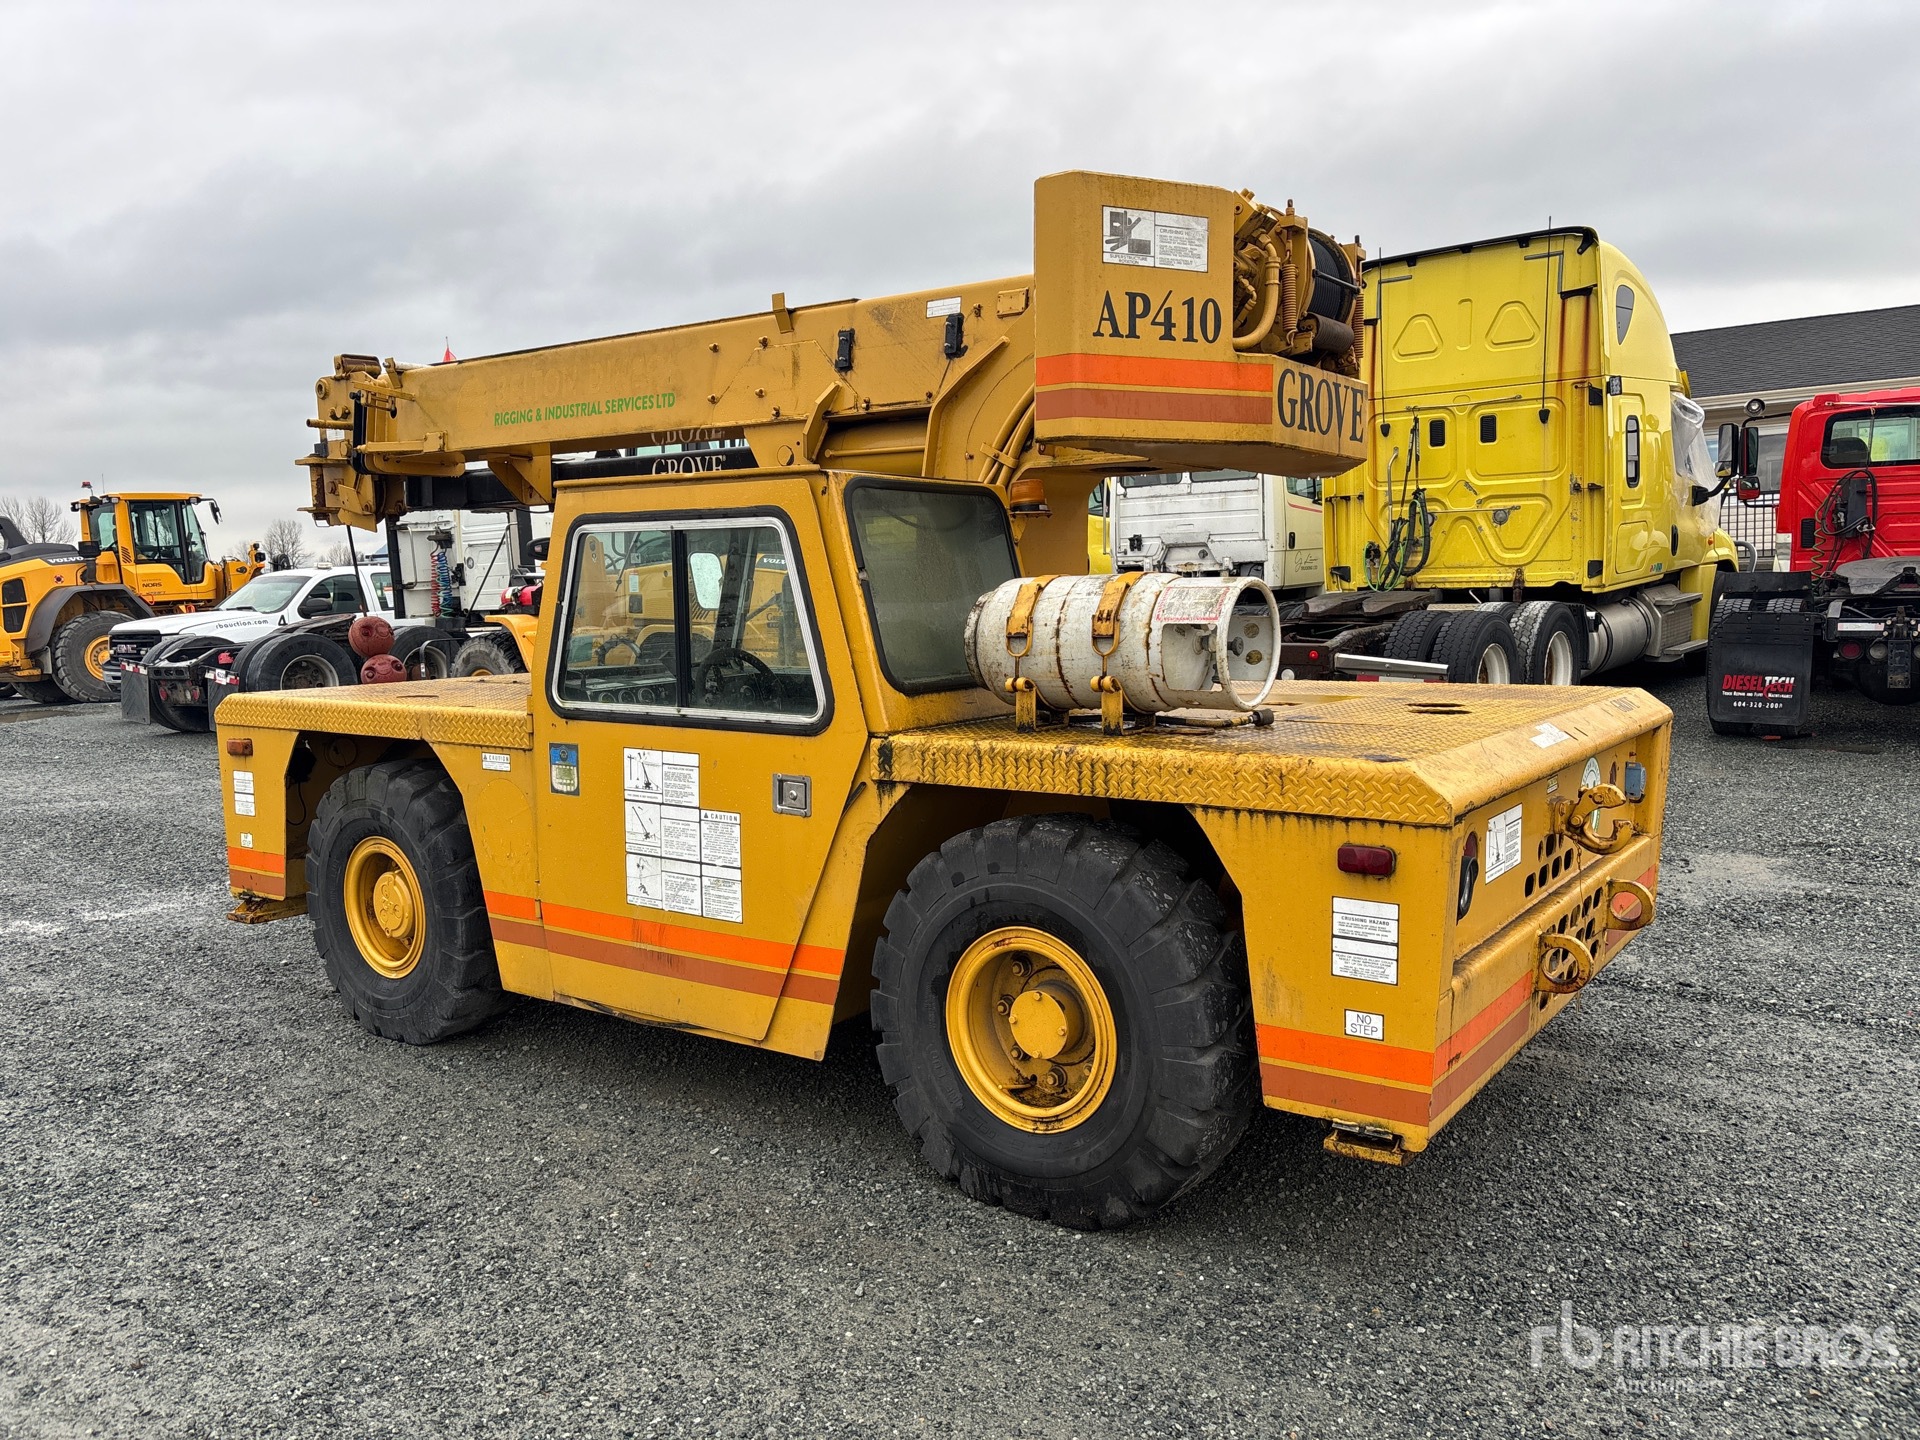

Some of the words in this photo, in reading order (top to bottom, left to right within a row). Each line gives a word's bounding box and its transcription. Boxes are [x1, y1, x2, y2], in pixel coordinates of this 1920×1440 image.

[1092, 289, 1222, 344] AP410
[494, 410, 533, 427] RIGGING
[535, 407, 542, 422] &
[544, 401, 603, 421] INDUSTRIAL
[605, 394, 655, 414] SERVICES
[656, 392, 676, 409] LTD
[1277, 368, 1364, 444] GROVE
[48, 556, 84, 564] VOLVO
[763, 557, 786, 565] VOLV
[215, 619, 269, 630] rbauction.com
[710, 812, 738, 822] CAUTION
[1341, 915, 1368, 924] CRUSHING
[1356, 1013, 1372, 1025] NO
[1350, 1023, 1378, 1036] STEP
